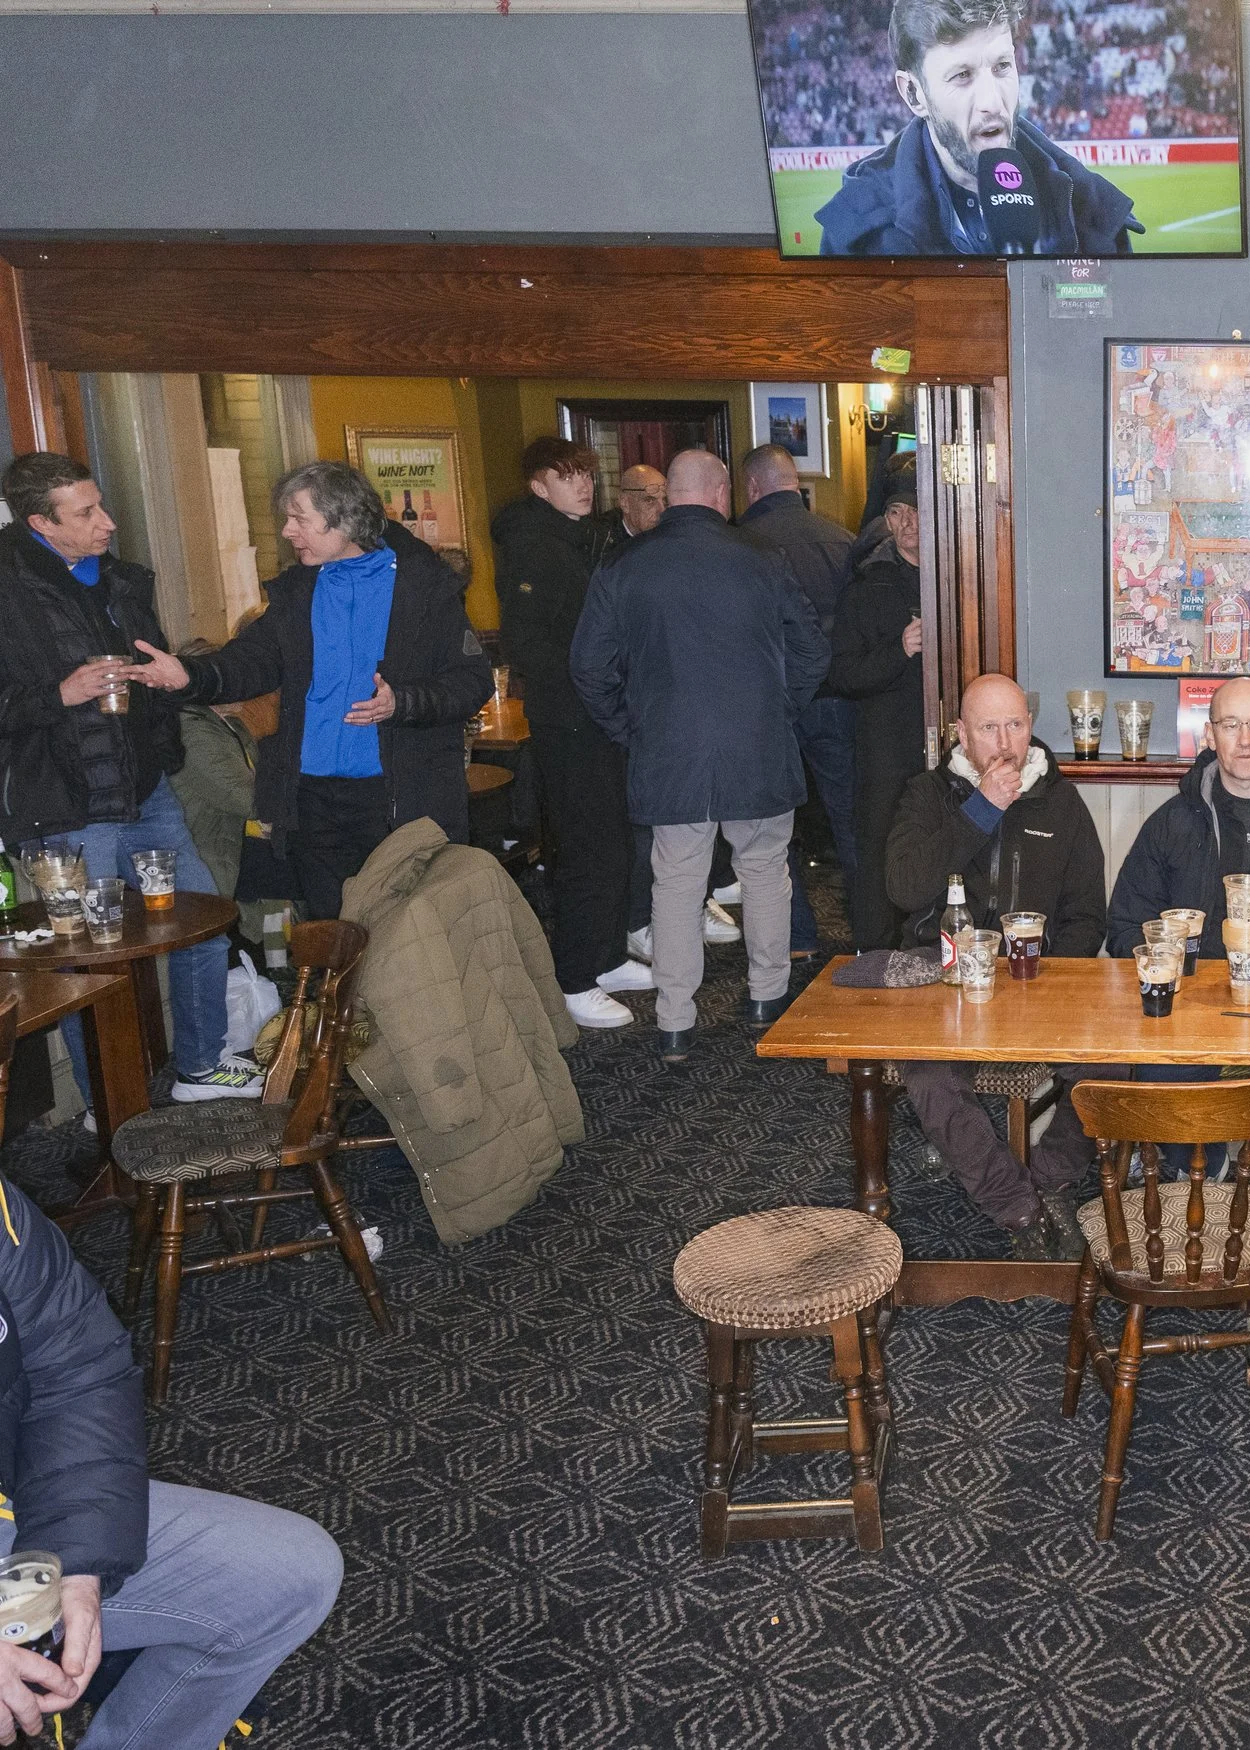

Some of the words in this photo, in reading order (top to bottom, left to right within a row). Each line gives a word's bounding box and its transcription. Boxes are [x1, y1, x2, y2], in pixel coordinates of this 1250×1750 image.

[994, 171, 1021, 182] TNT
[990, 193, 1035, 206] SPORTS
[1071, 267, 1090, 278] FOR
[1061, 286, 1104, 297] MACMILLAN
[368, 448, 400, 465] WINE
[401, 448, 442, 465] NIGHT?
[378, 466, 406, 477] WINE
[409, 465, 435, 476] NOT?
[1182, 596, 1204, 604] JOHN
